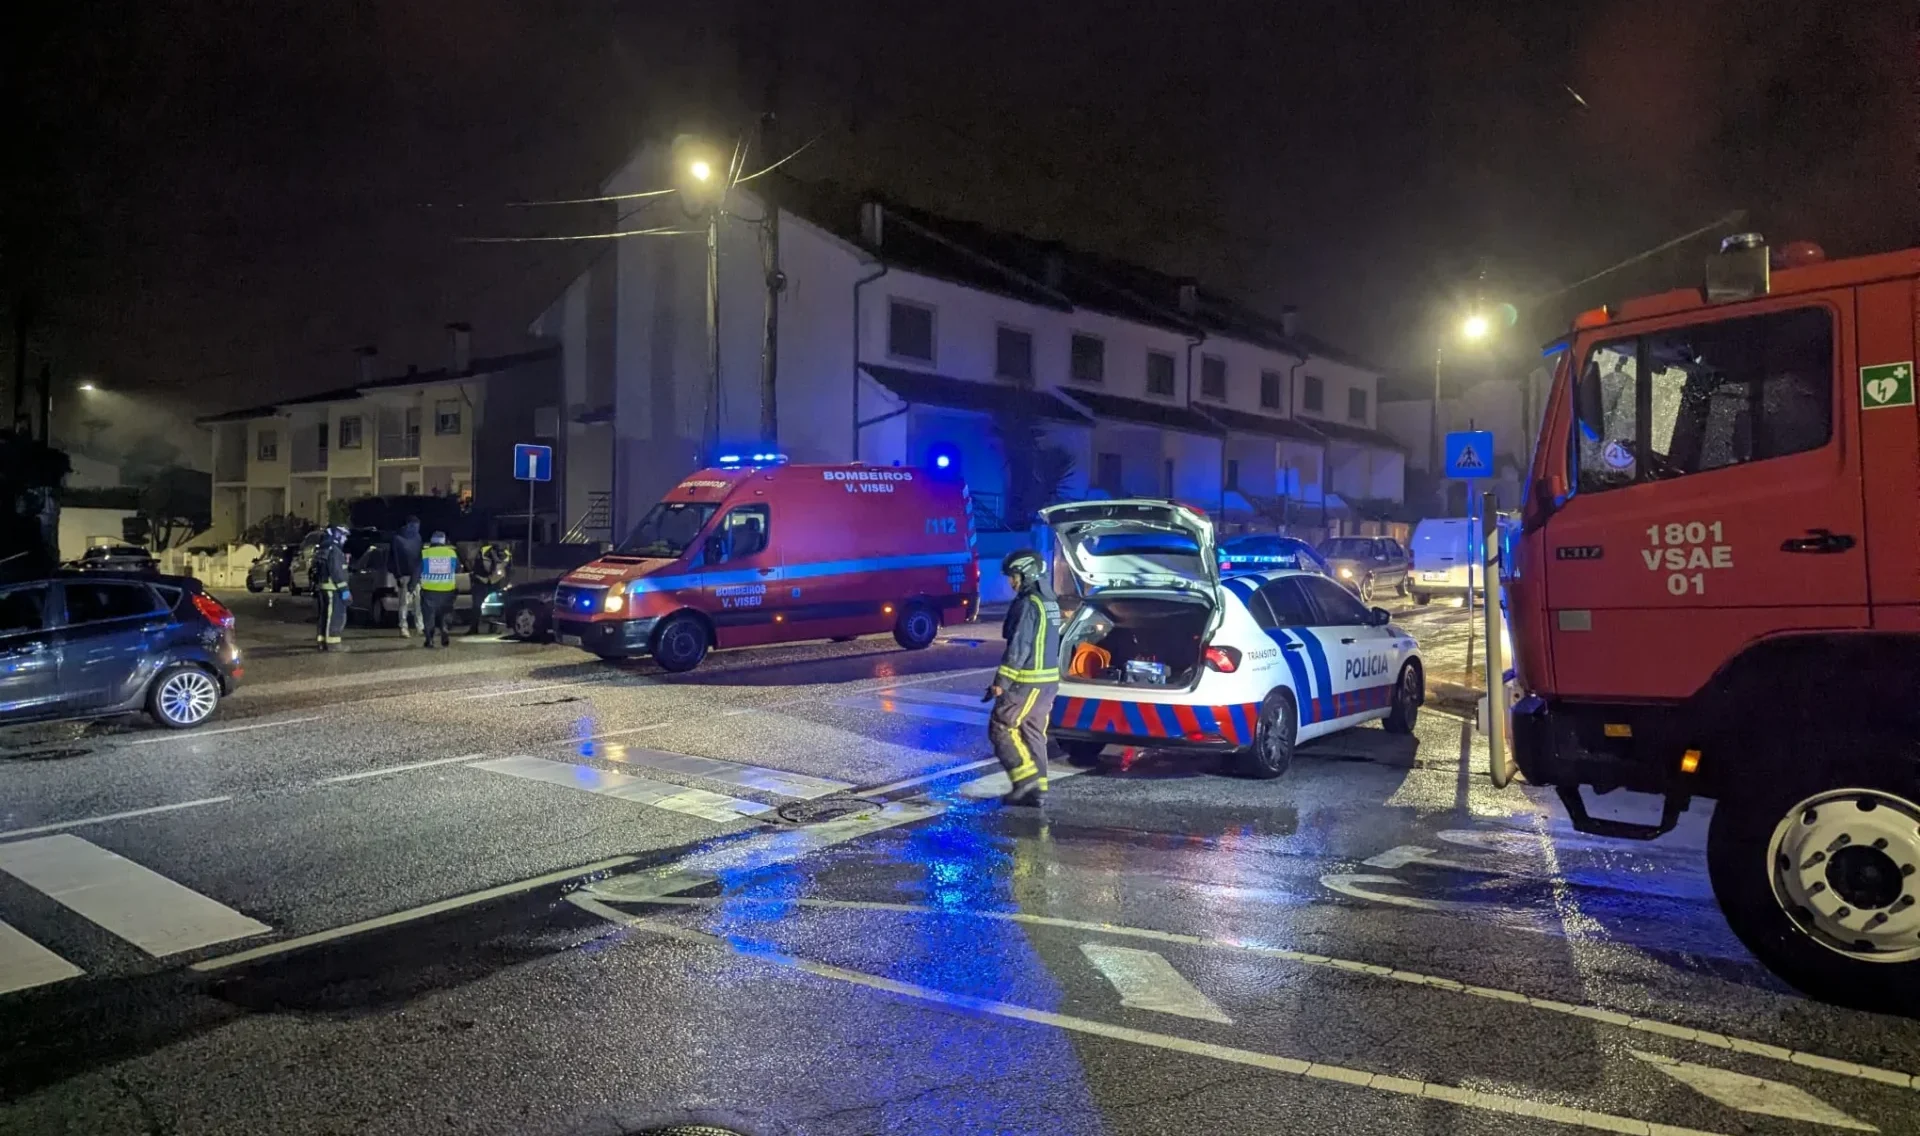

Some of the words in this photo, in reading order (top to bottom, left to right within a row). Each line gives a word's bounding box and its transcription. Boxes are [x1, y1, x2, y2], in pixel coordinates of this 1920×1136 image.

[823, 471, 912, 480] BOMBEIROS
[845, 483, 858, 493] V.
[859, 483, 894, 493] VISEU
[1646, 521, 1723, 545] 1801
[1641, 546, 1734, 571] VSAE
[715, 584, 767, 597] BOMBEIROS
[1667, 573, 1705, 595] 01
[722, 598, 732, 608] V.
[734, 595, 762, 607] VISEU
[1345, 649, 1388, 681] POLÍCIA
